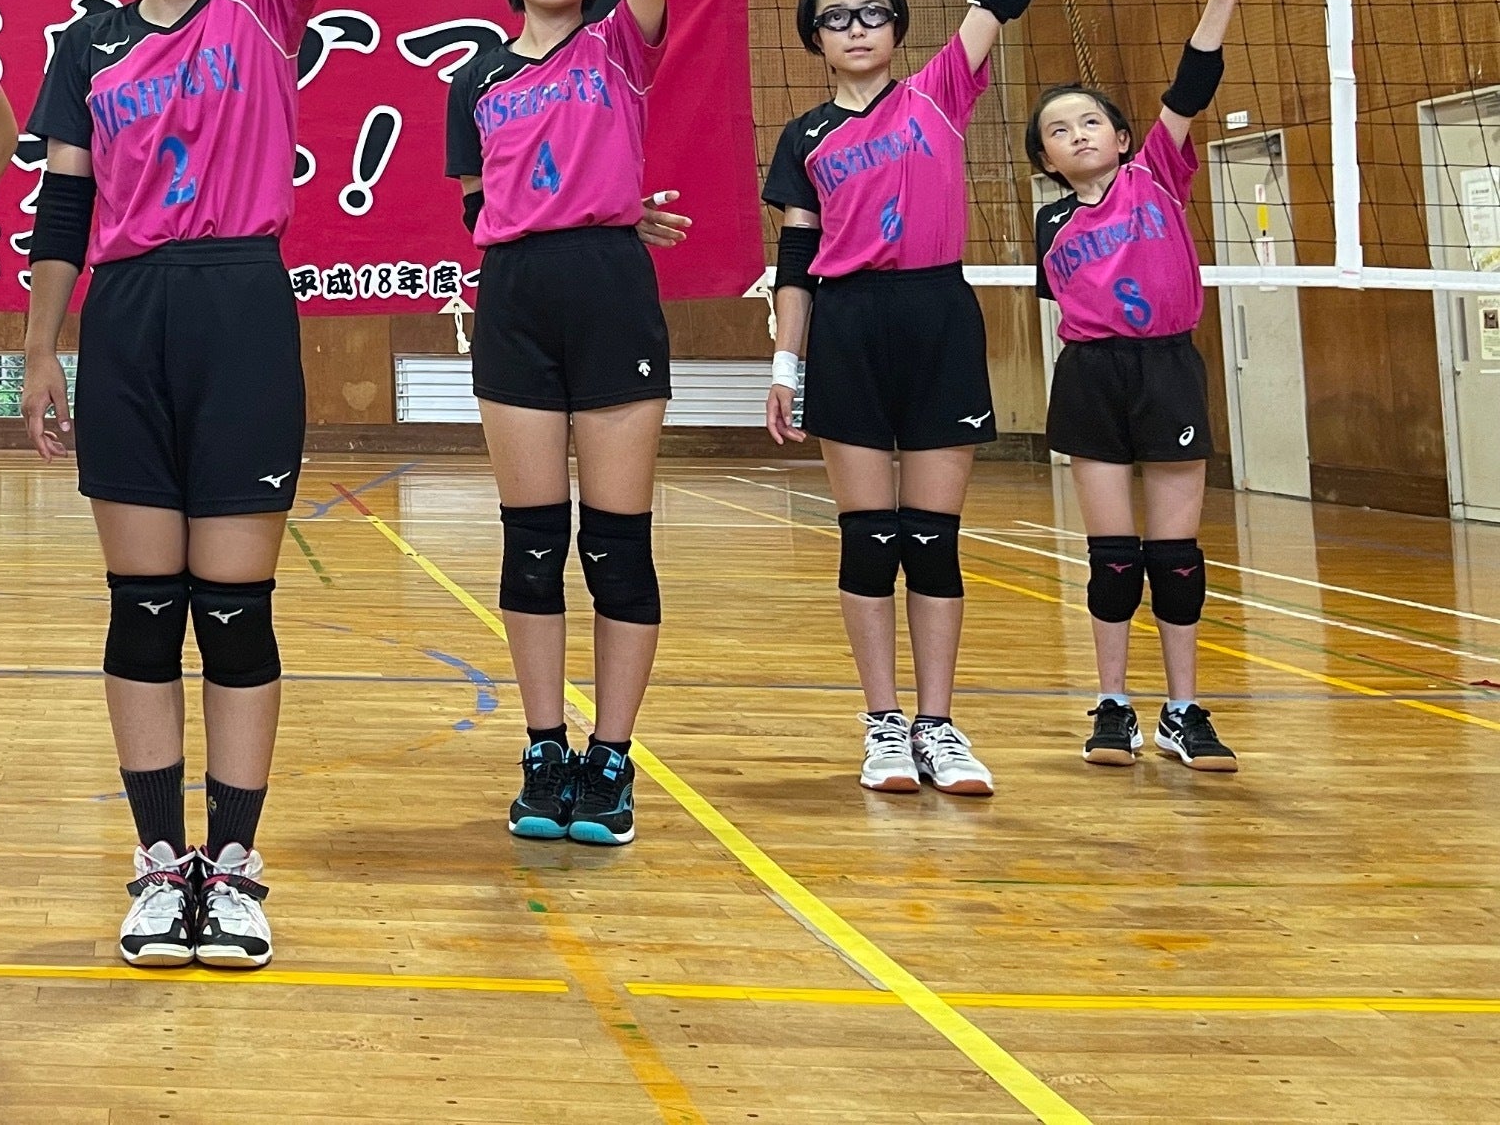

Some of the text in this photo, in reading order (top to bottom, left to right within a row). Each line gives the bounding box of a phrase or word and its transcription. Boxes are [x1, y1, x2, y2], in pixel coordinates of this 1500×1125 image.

[156, 135, 197, 208] 2
[531, 140, 562, 196] 4
[880, 194, 904, 243] 6
[289, 260, 481, 302] 平成18年度
[1113, 276, 1153, 330] 8
